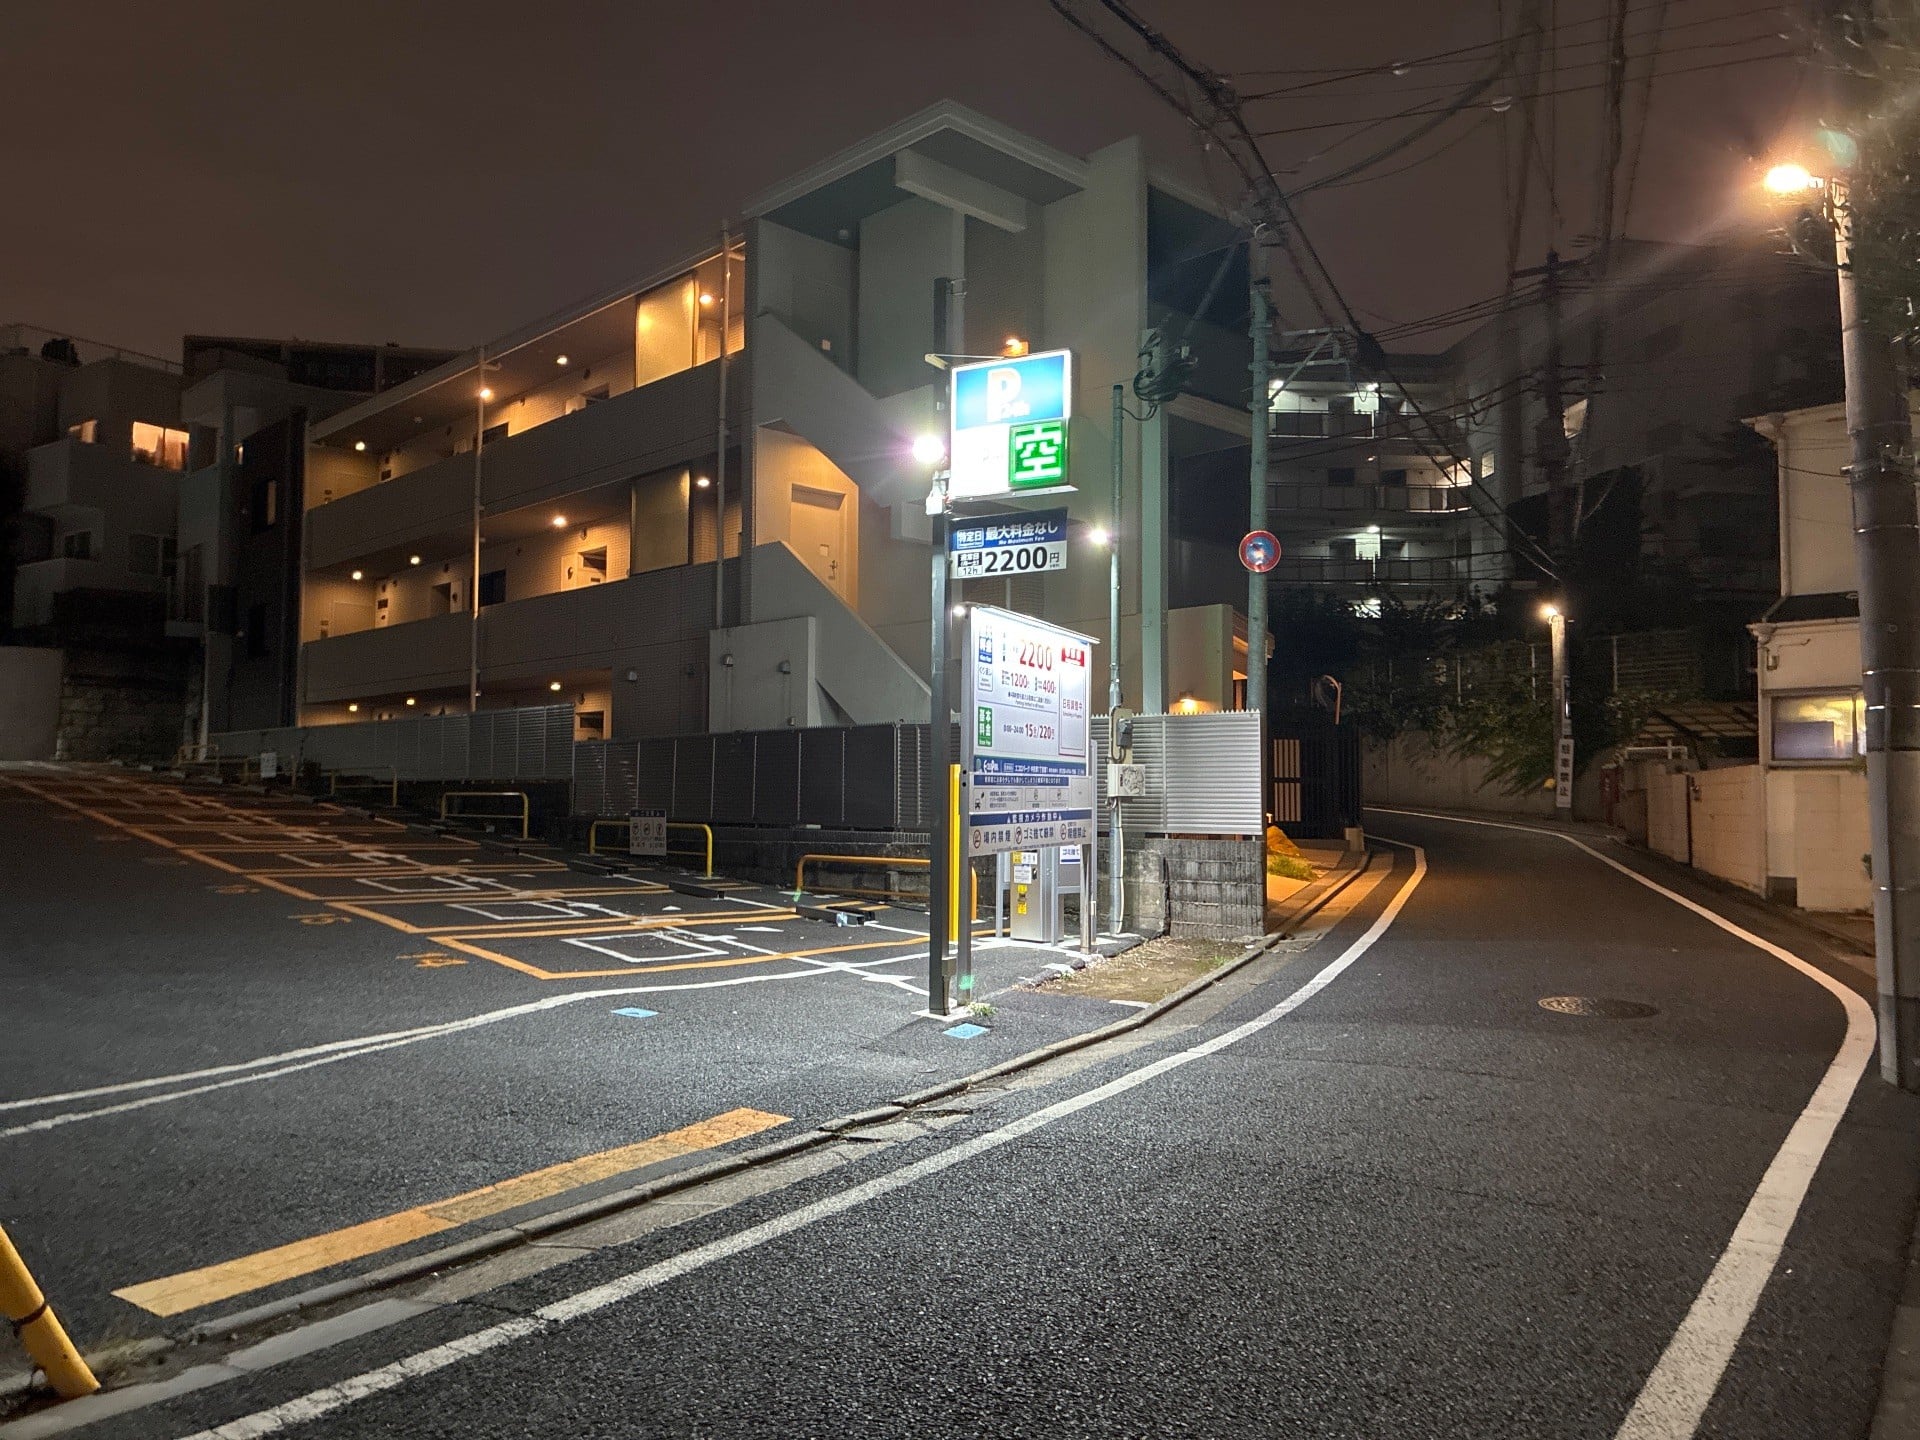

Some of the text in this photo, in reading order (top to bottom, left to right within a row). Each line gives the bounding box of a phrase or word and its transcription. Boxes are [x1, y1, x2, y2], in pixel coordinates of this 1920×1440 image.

[1015, 424, 1062, 478] 空
[958, 521, 1058, 542] 特定日 最大料金なし
[1019, 640, 1052, 671] 2200
[984, 830, 1011, 844] 場内禁煙
[1023, 827, 1054, 840] ゴミ捨て厳禁
